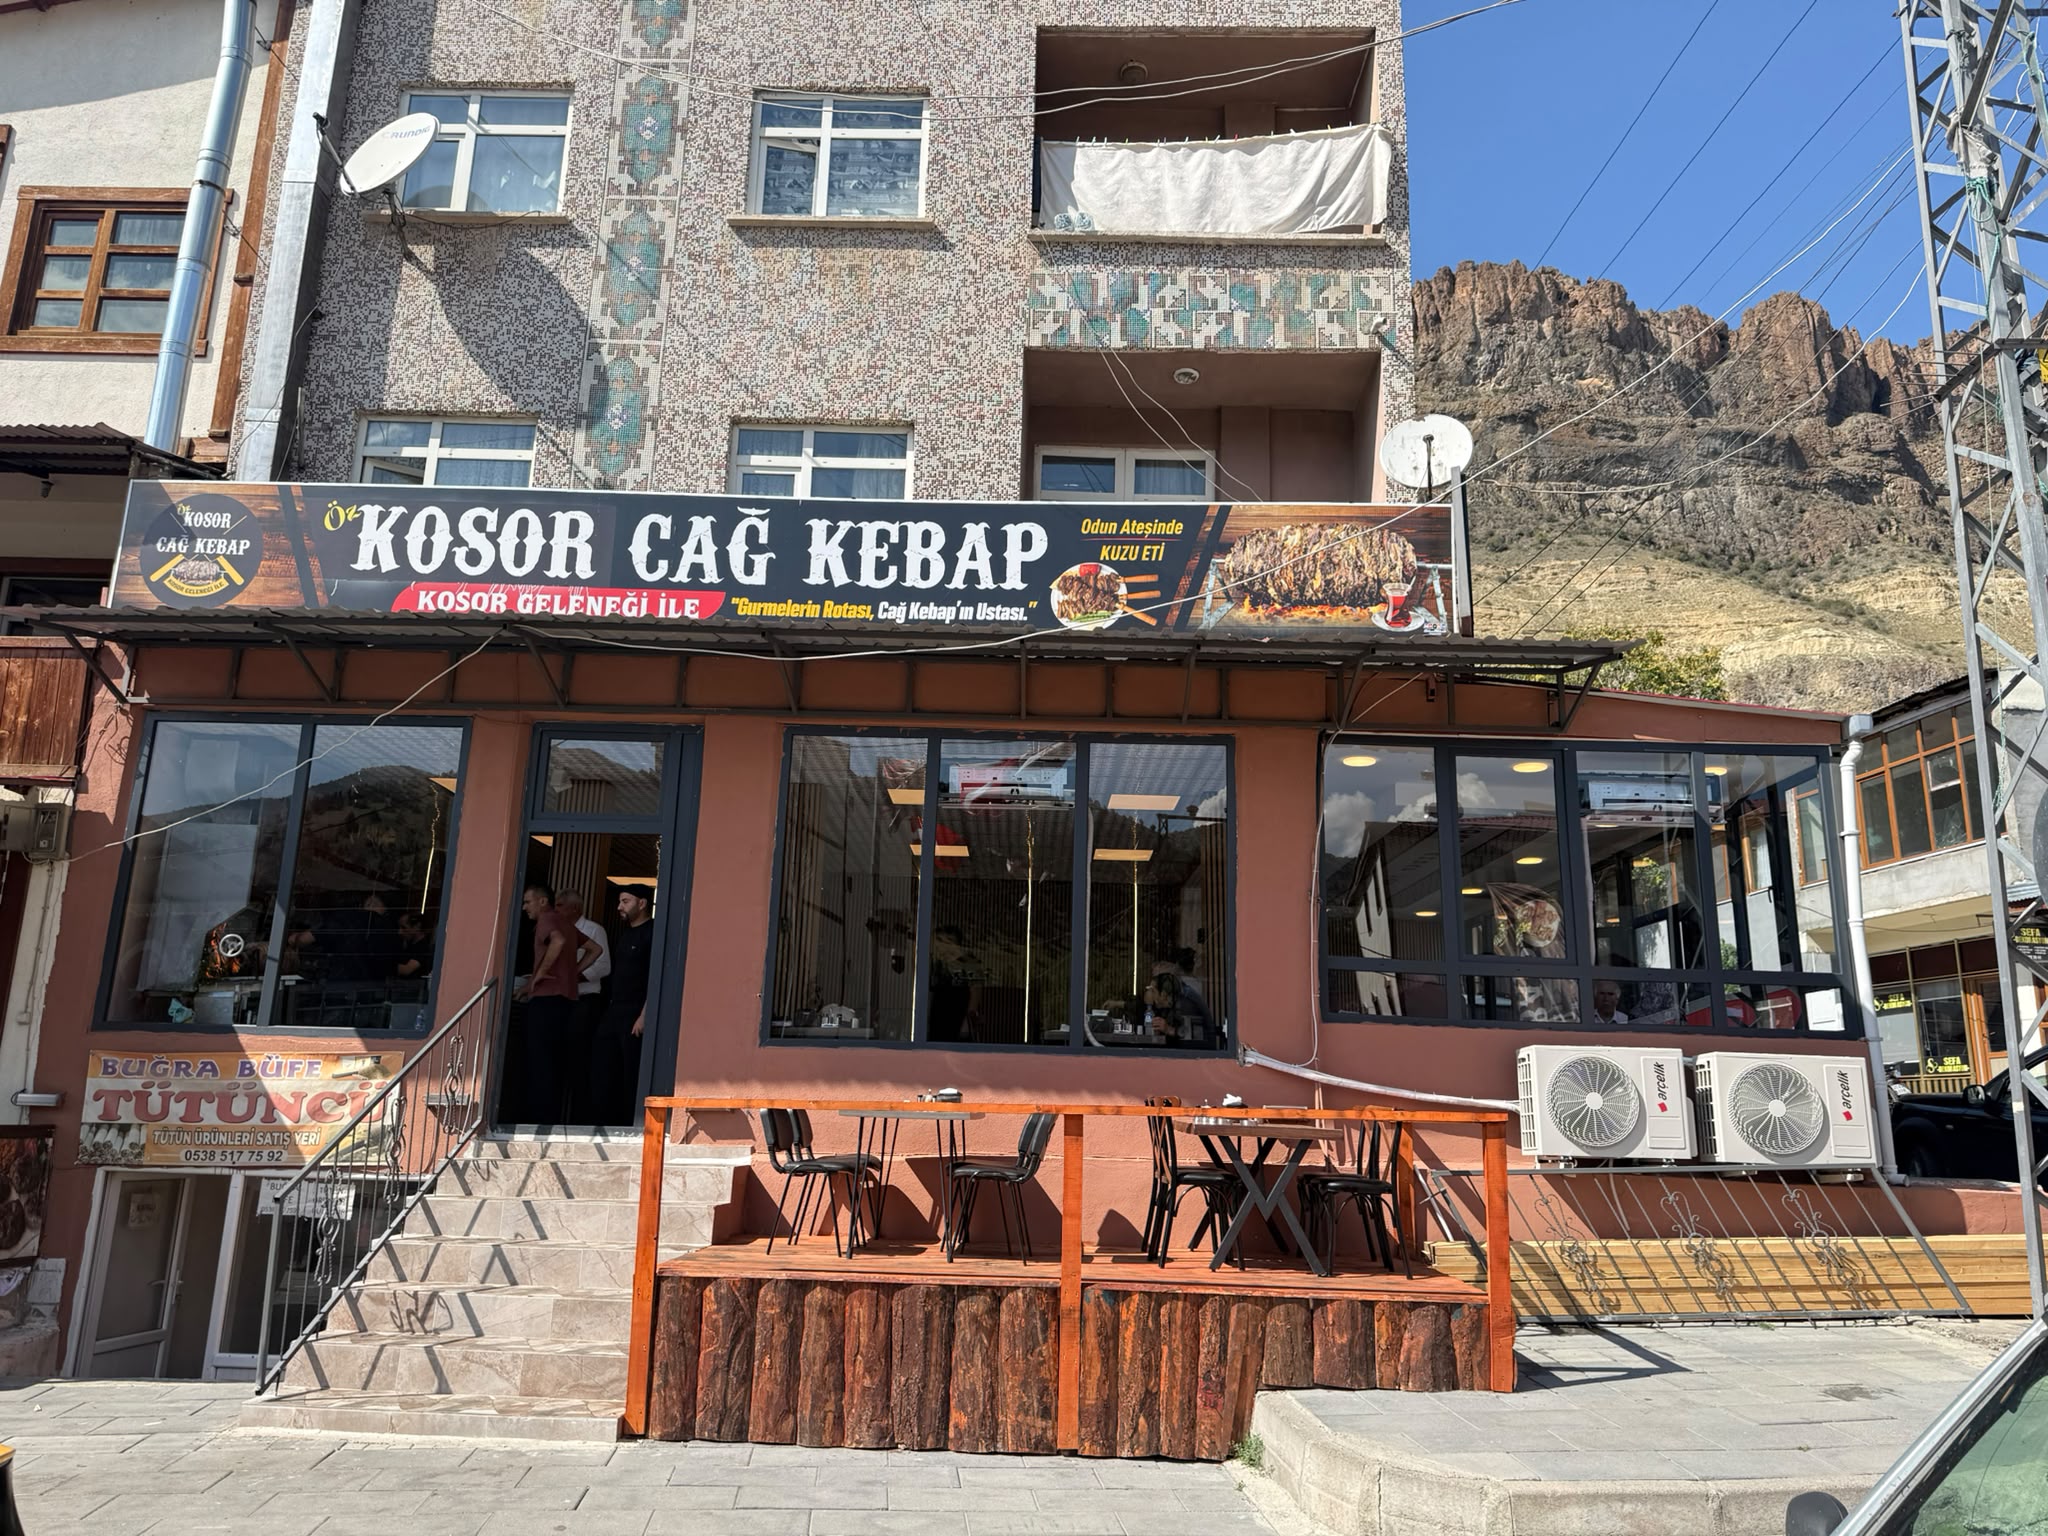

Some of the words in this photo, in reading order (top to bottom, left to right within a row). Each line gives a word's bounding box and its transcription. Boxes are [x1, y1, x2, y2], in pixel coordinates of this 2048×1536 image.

[184, 512, 231, 528] KOSOR
[1081, 518, 1118, 534] Odun
[1120, 519, 1183, 538] Ateşinde
[156, 535, 189, 553] CAĞ
[194, 538, 250, 555] KEBAP
[323, 500, 362, 531] Öz
[350, 504, 597, 580] KOSOR
[628, 506, 776, 585] CAĞ
[801, 518, 1048, 591] KEBAP
[1100, 544, 1140, 560] KUZU
[1142, 542, 1165, 561] ETİ
[417, 590, 507, 612] KOSOR
[517, 592, 648, 617] GELENEĞİ
[657, 592, 700, 619] İLE
[731, 597, 820, 618] "Gurmelerin
[822, 600, 875, 620] Rotası,
[878, 601, 907, 624] Cağ
[908, 600, 974, 624] Kebap'ın
[101, 1055, 220, 1078] BUĞRA
[236, 1054, 322, 1079] BÜFE
[1943, 1056, 1961, 1065] SEFA
[1653, 1061, 1668, 1100] arçelik
[1837, 1070, 1853, 1109] arçelik
[93, 1080, 393, 1124] TÜTÜNCÜ
[153, 1127, 193, 1145] TÜTÜN
[194, 1127, 255, 1146] ÜRÜNLERİ
[256, 1129, 291, 1149] SATIŞ
[294, 1127, 322, 1146] YERİ
[184, 1150, 216, 1161] 0538
[220, 1150, 244, 1162] 517
[246, 1151, 266, 1162] 75
[266, 1151, 283, 1162] 92
